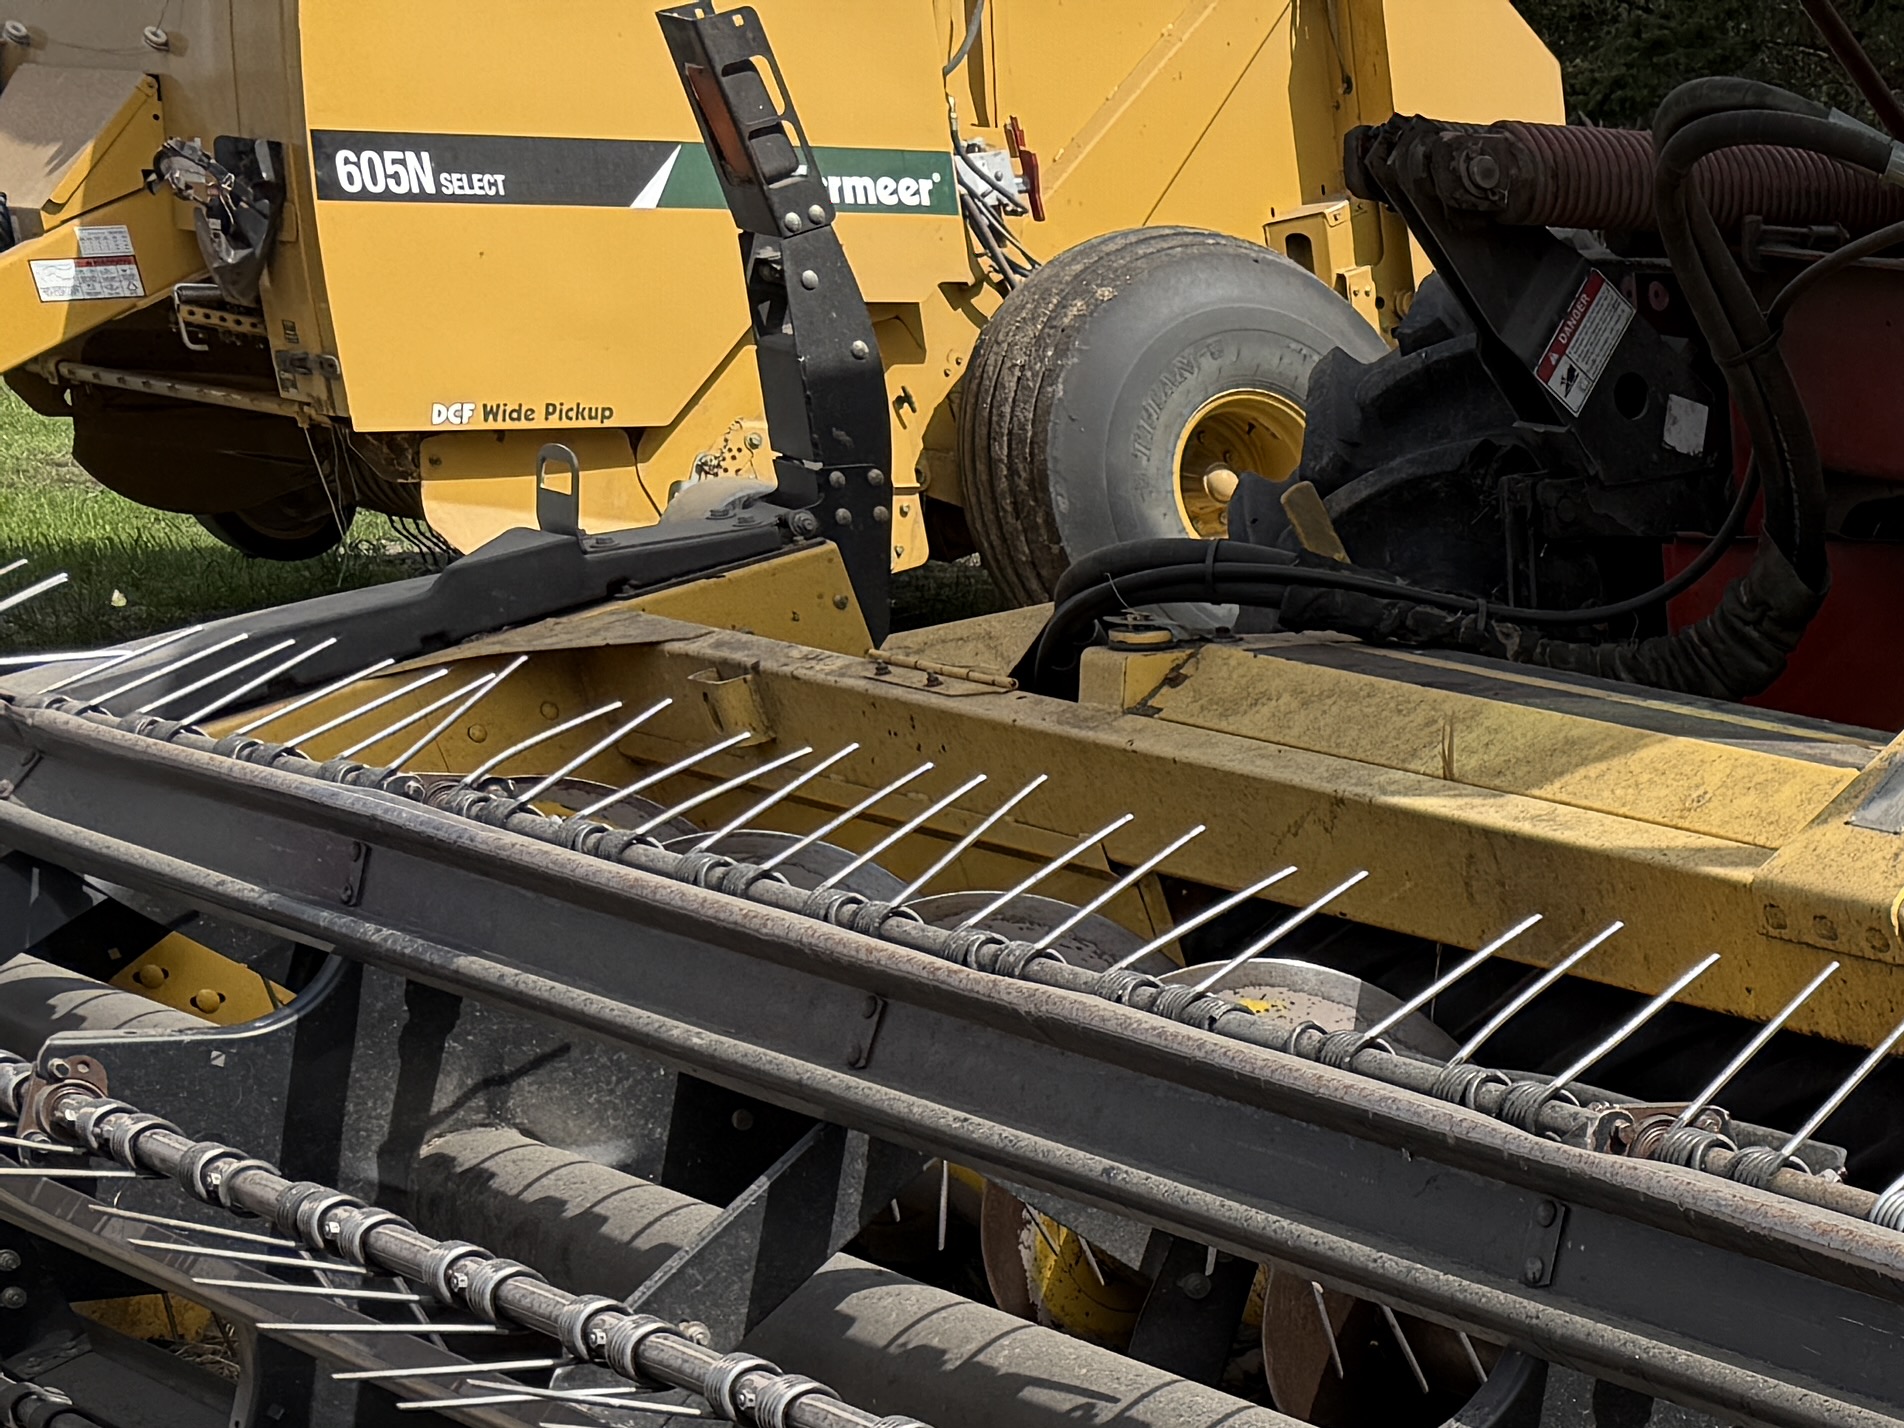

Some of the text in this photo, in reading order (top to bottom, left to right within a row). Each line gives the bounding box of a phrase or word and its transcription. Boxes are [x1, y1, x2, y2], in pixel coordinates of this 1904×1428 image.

[335, 149, 505, 196] 605N SELECT
[790, 164, 934, 206] rmeer
[1557, 293, 1591, 345] DANGER
[431, 402, 614, 425] DCF Wide Pickup
